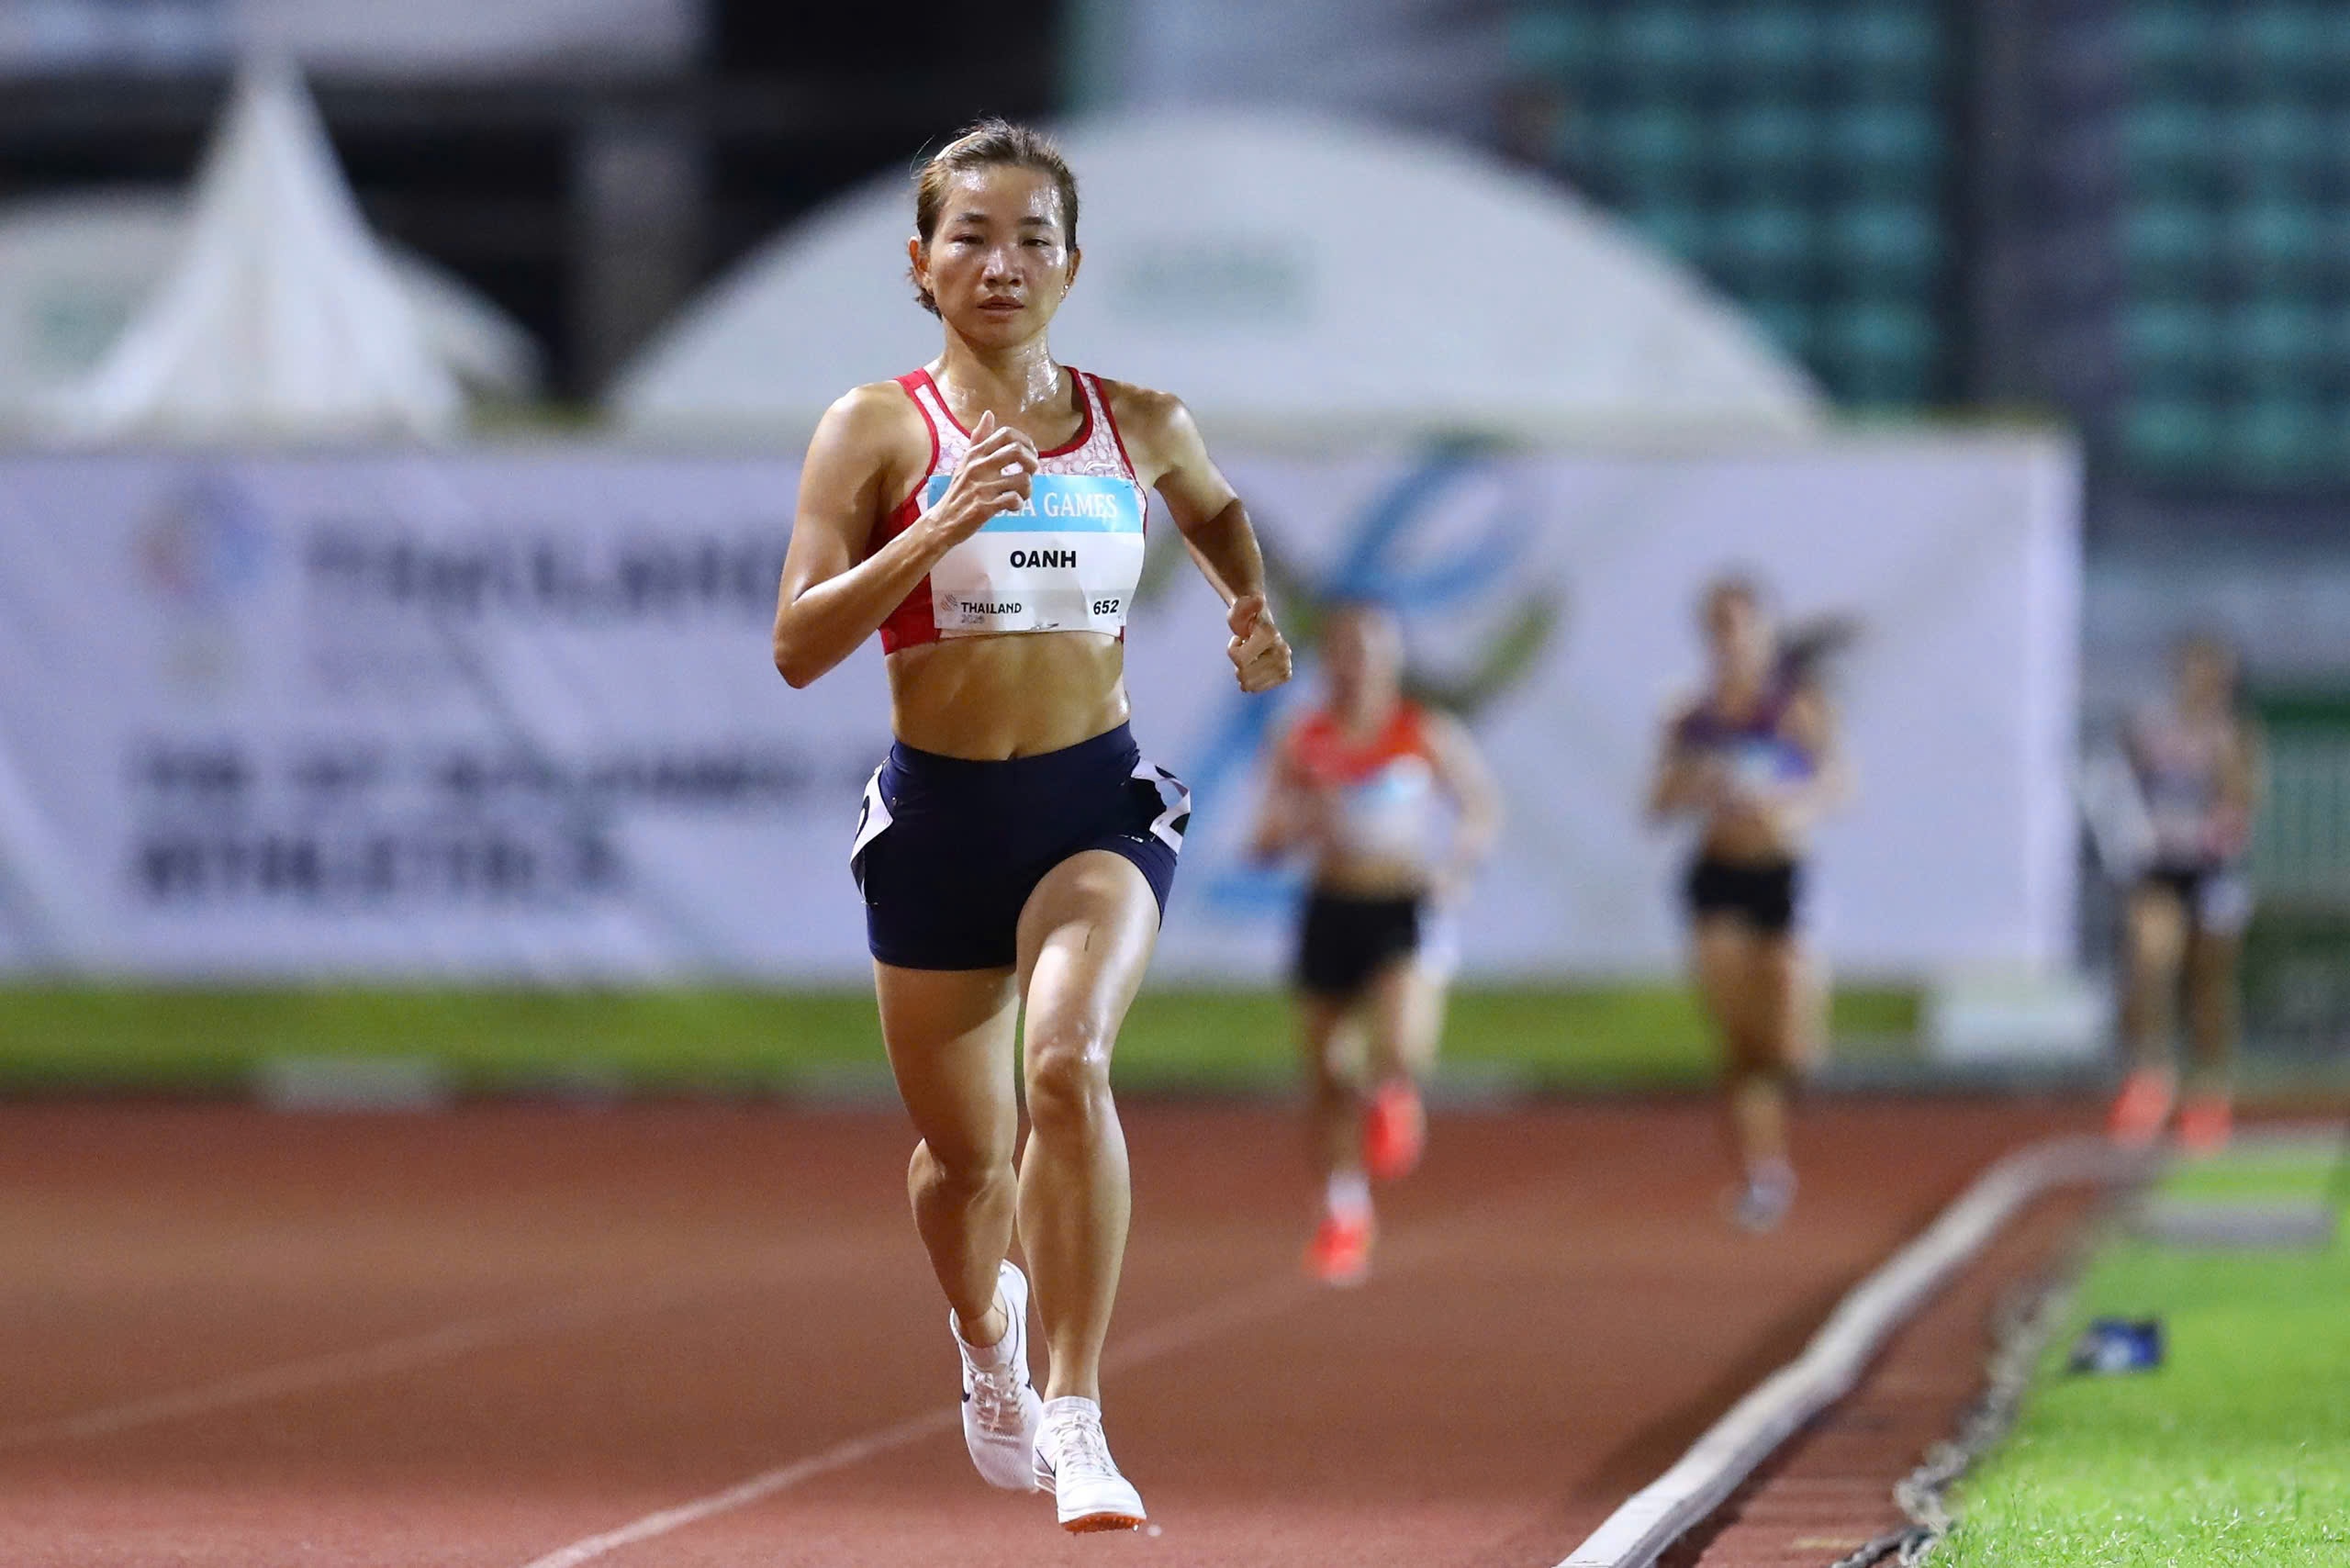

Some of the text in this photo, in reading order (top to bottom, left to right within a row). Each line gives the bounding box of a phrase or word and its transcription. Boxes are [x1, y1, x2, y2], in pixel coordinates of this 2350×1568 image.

[1043, 492, 1118, 519] GAMES
[1010, 550, 1077, 568] OANH
[960, 601, 1023, 614] THAILAND
[1092, 599, 1120, 615] 652
